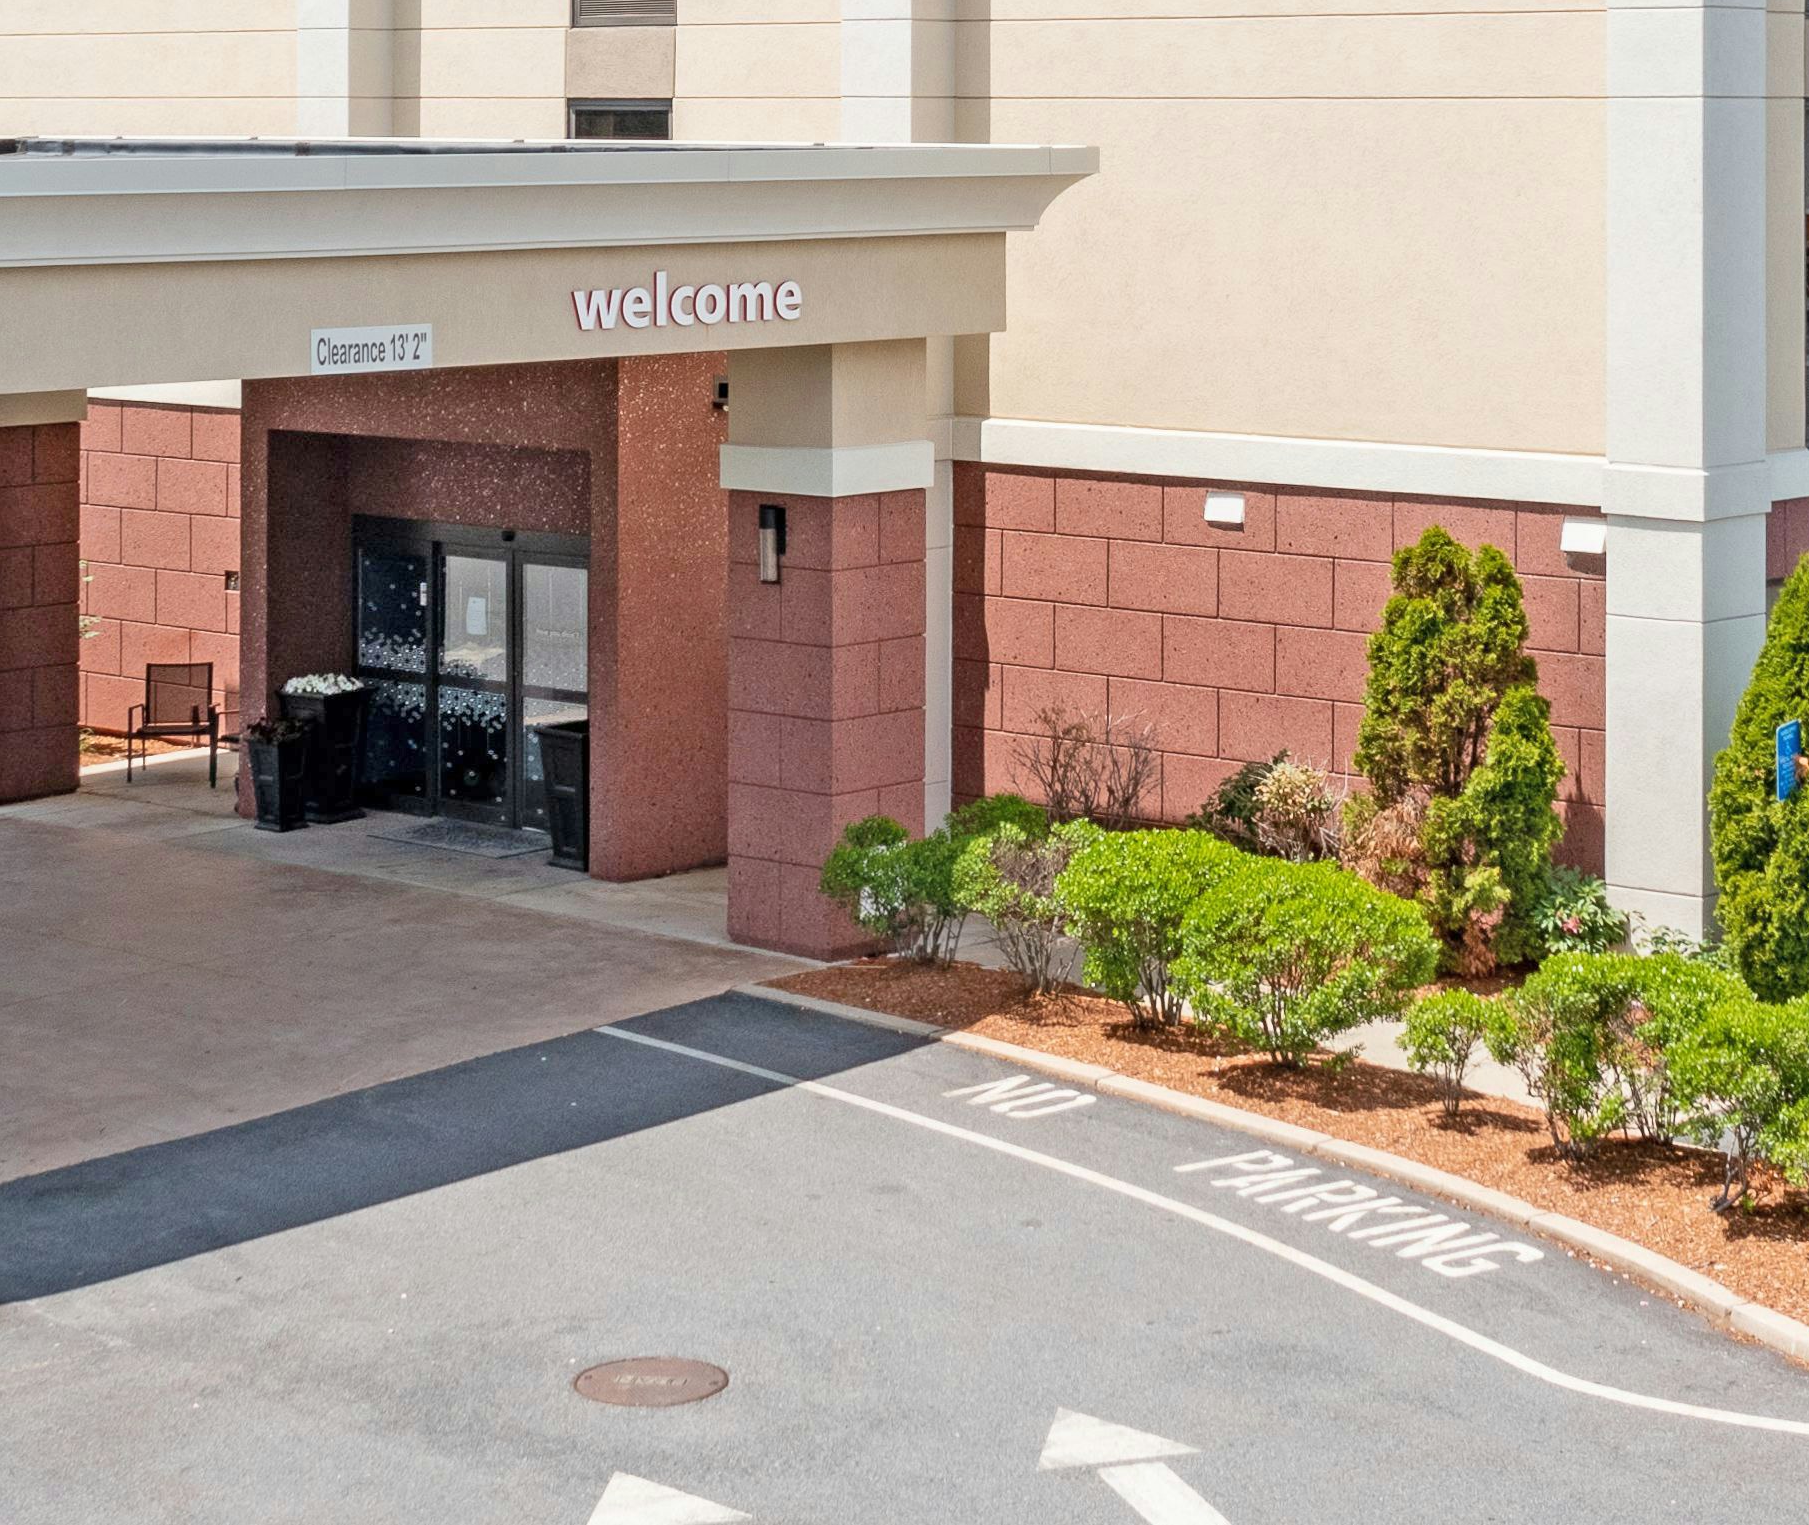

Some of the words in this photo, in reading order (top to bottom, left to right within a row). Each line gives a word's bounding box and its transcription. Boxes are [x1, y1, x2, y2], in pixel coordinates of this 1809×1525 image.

[571, 270, 803, 331] welcome
[317, 337, 386, 366] Clearance
[390, 333, 409, 361] 13'
[413, 332, 427, 360] 2"
[942, 1075, 1097, 1119] NO
[1173, 1148, 1545, 1277] PARKING
